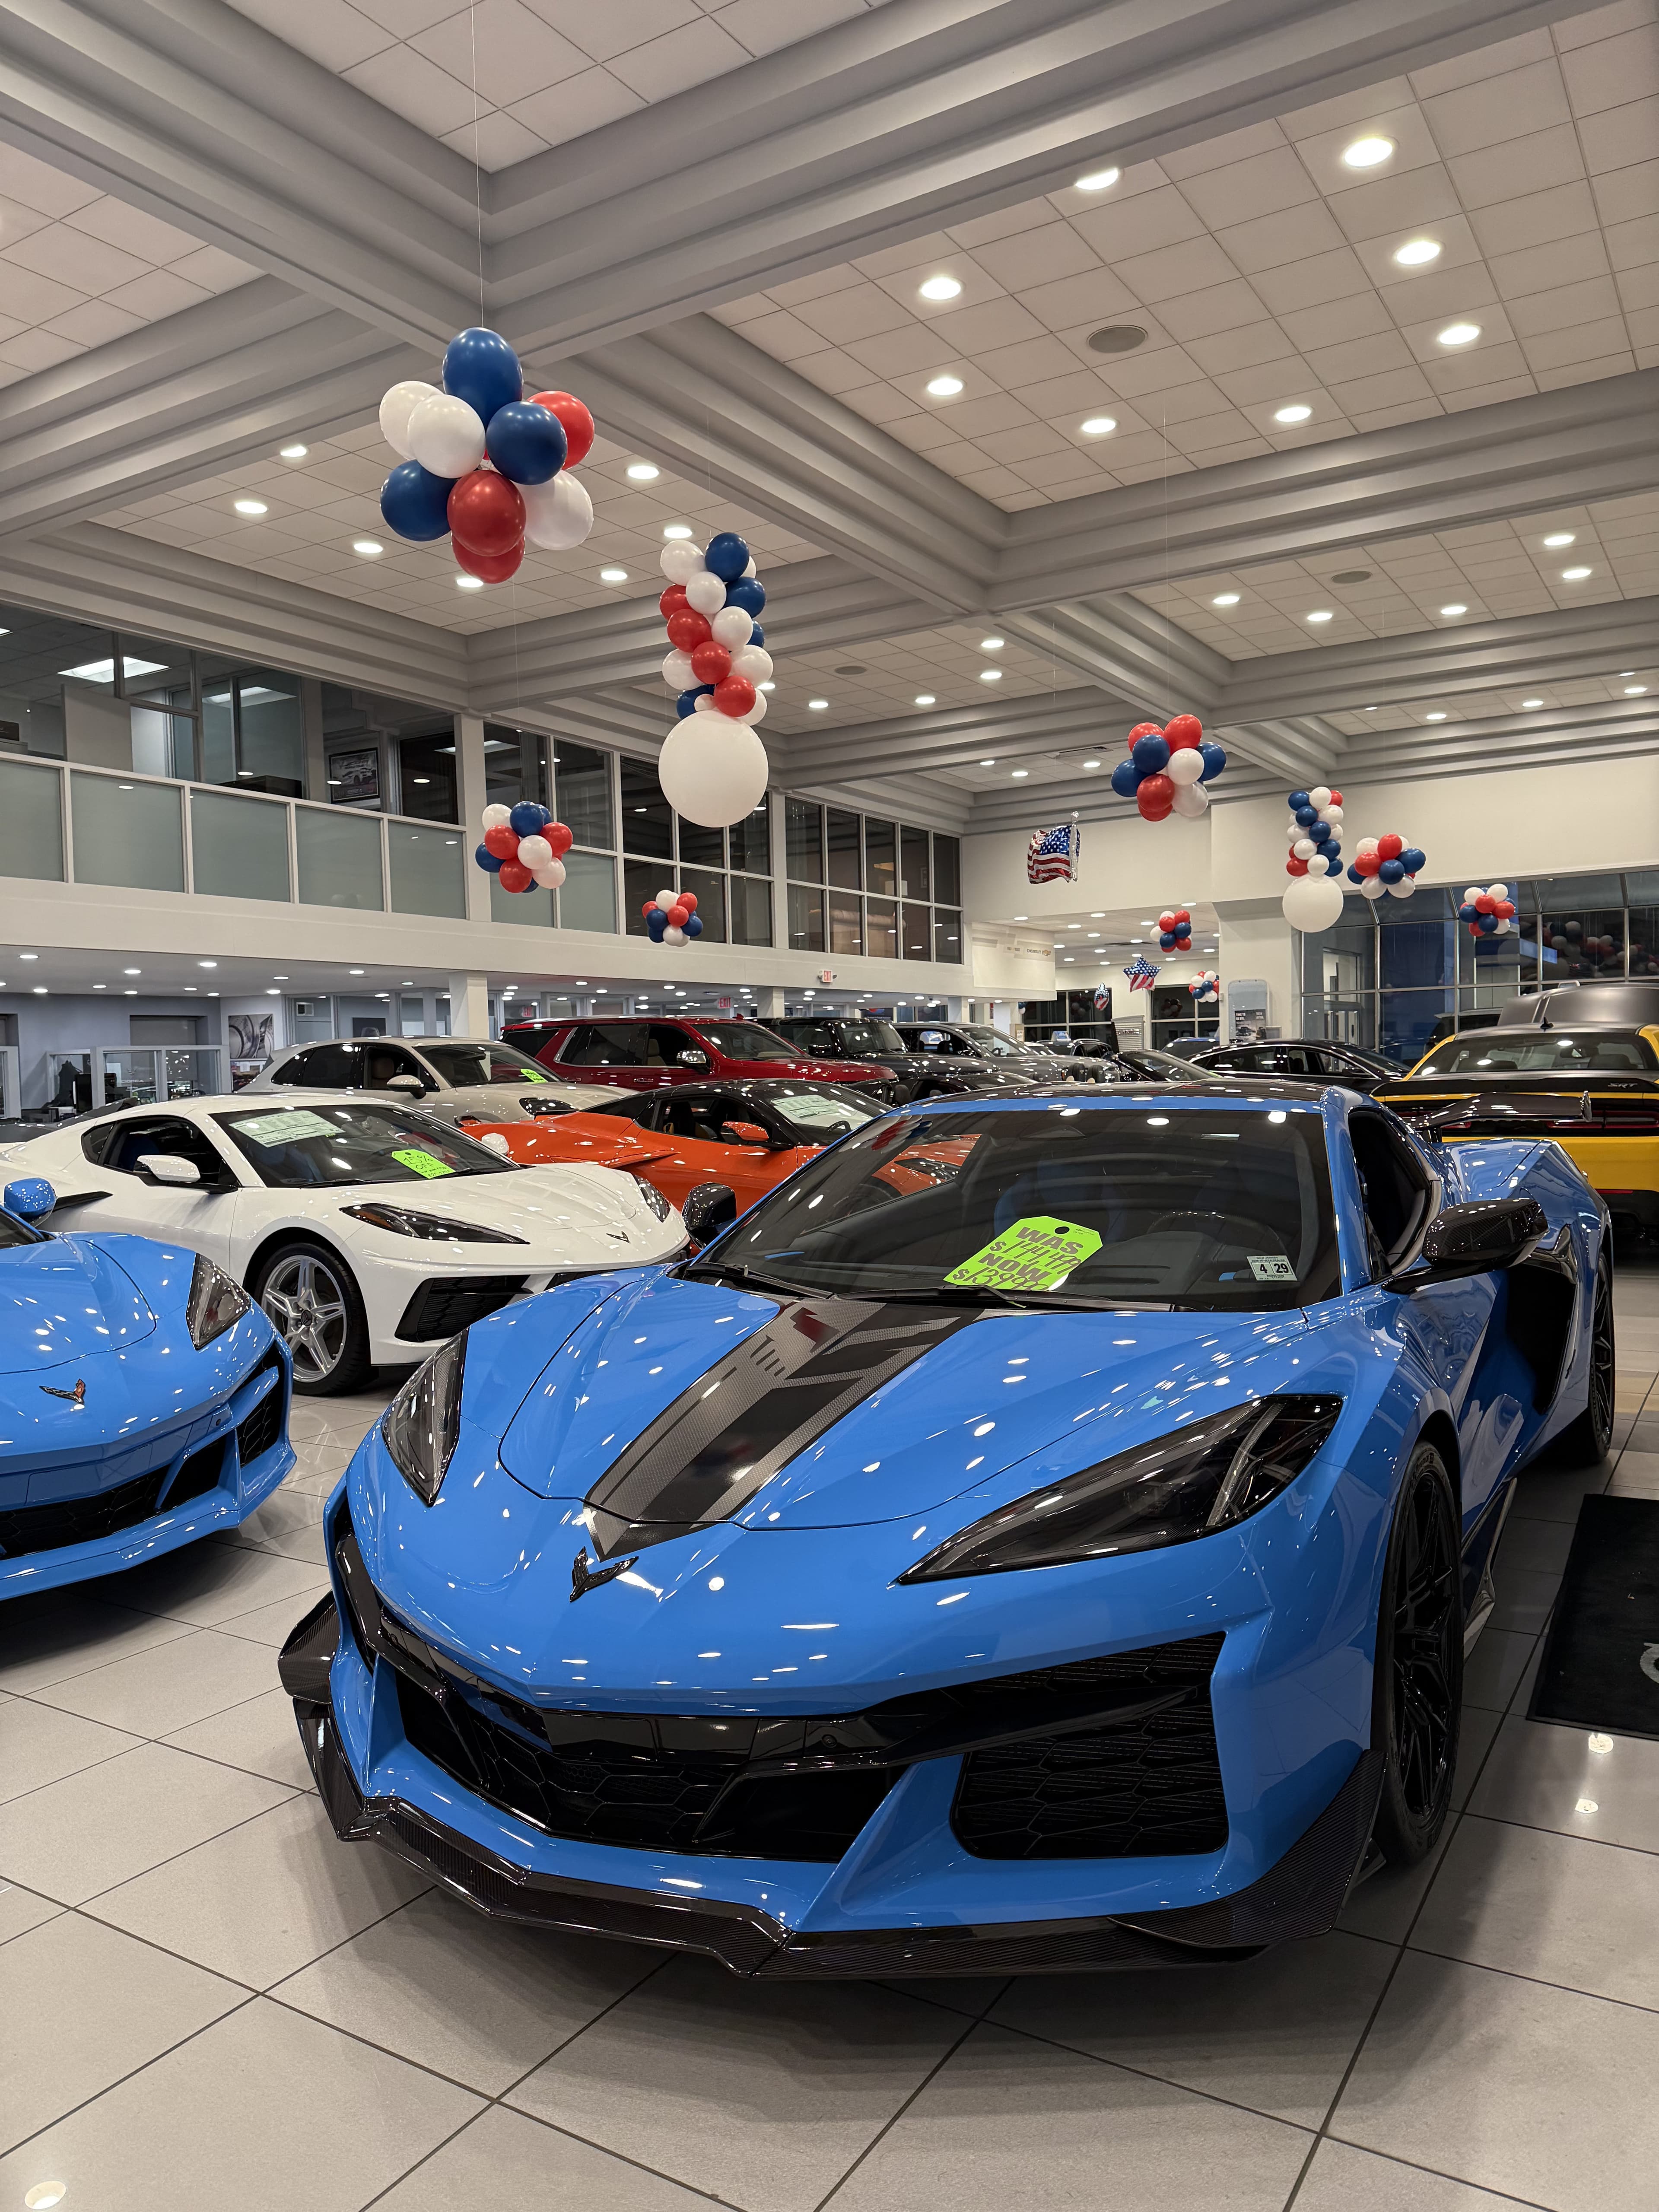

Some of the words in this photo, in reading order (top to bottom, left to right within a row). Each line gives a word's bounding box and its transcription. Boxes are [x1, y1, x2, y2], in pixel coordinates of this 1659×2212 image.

[719, 998, 731, 1008] EXIT
[403, 1155, 433, 1165] 15%
[1016, 1227, 1084, 1254] WAS
[978, 1253, 1052, 1283] NOW
[1260, 1264, 1268, 1274] 4
[1274, 1263, 1289, 1273] 29
